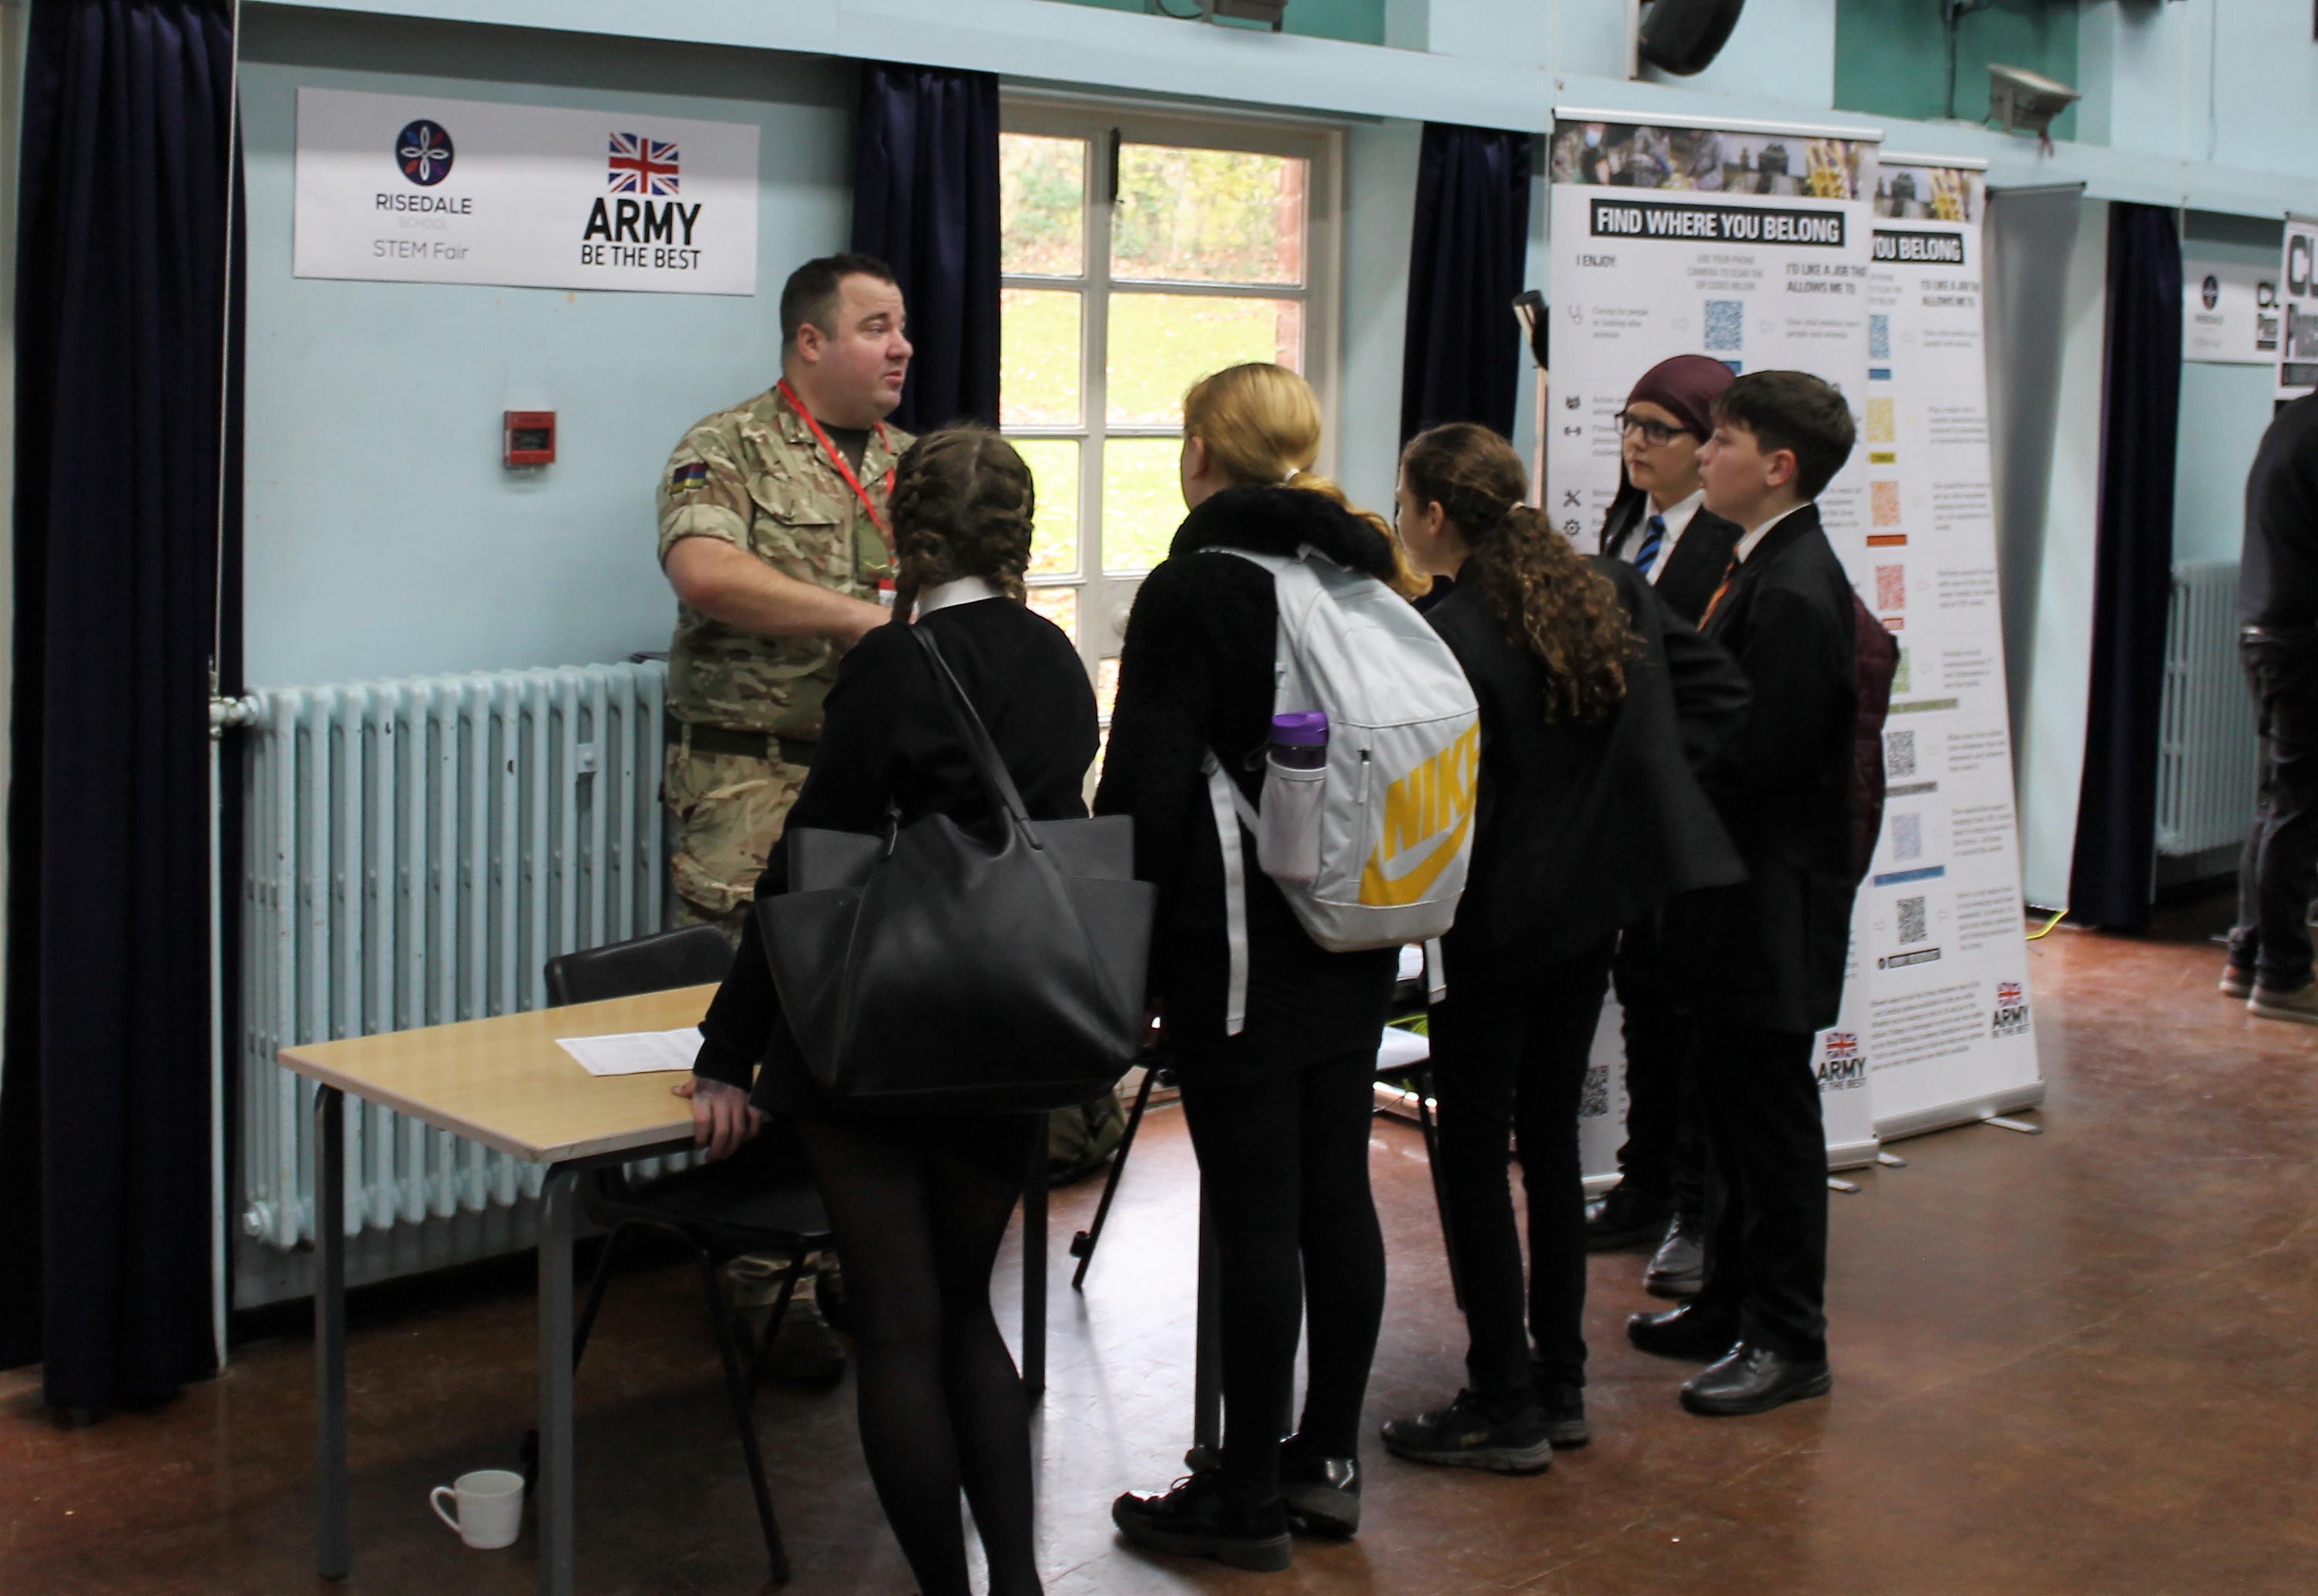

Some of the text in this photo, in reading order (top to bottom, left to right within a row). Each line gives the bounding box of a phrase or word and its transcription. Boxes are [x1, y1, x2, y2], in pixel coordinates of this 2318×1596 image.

[376, 193, 472, 214] RISEDALE
[399, 217, 448, 230] SCHOOL
[583, 197, 702, 245] ARMY
[1597, 207, 1839, 243] FIND WHERE YOU BELONG
[373, 240, 469, 260] STEM Fair
[582, 245, 701, 270] BE THE BEST
[1899, 237, 1961, 261] BELONG
[1787, 281, 1827, 293] ALLOWS
[1829, 283, 1842, 294] ME
[1992, 1005, 2030, 1030] ARMY
[1817, 1057, 1866, 1080] ARMY
